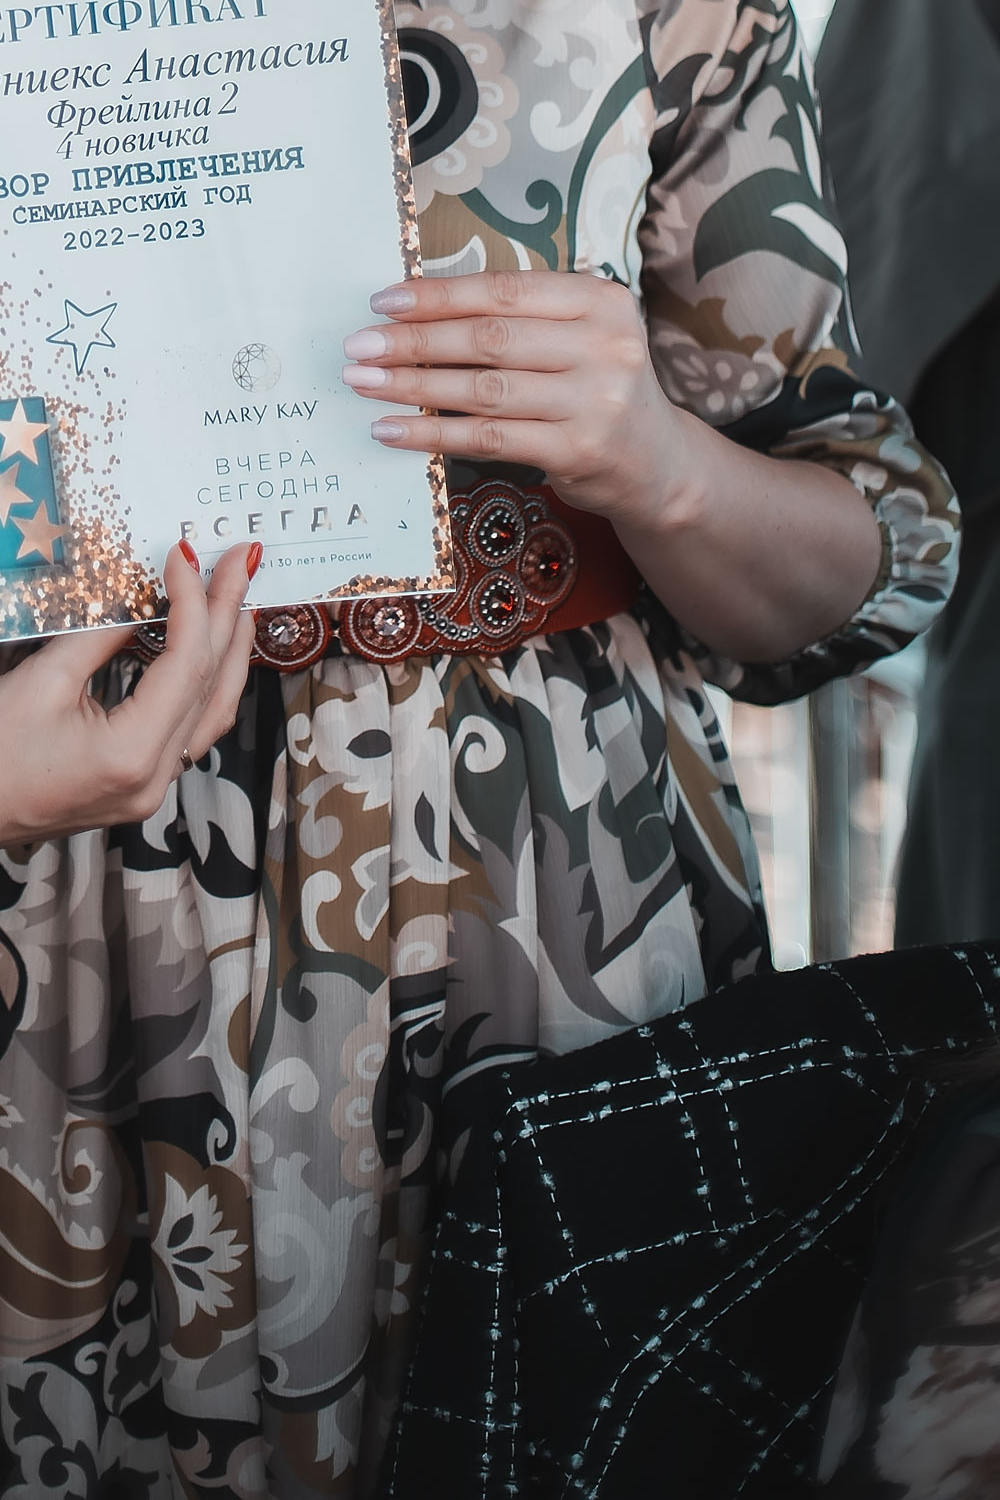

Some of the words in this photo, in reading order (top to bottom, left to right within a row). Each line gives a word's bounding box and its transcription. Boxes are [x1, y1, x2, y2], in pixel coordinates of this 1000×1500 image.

[123, 37, 349, 84] Анастасия
[47, 94, 211, 135] Фрейлина
[217, 81, 239, 115] 2
[56, 131, 74, 160] 4
[85, 125, 210, 157] новичка
[72, 146, 305, 191] ПРИВЛЕЧЕНИЯ
[13, 185, 187, 224] СЕМИНАРСКИЙ
[203, 184, 252, 204] ГОД
[64, 218, 206, 250] 2022-2023
[203, 404, 267, 426] MARY
[277, 400, 319, 420] KAY
[216, 450, 316, 475] ВЧЕРА
[197, 475, 340, 504] СЕГОДНЯ
[180, 504, 367, 540] ВСЕГДА
[277, 558, 292, 568] 30
[296, 556, 316, 567] лет
[319, 556, 326, 564] в
[330, 551, 372, 563] России
